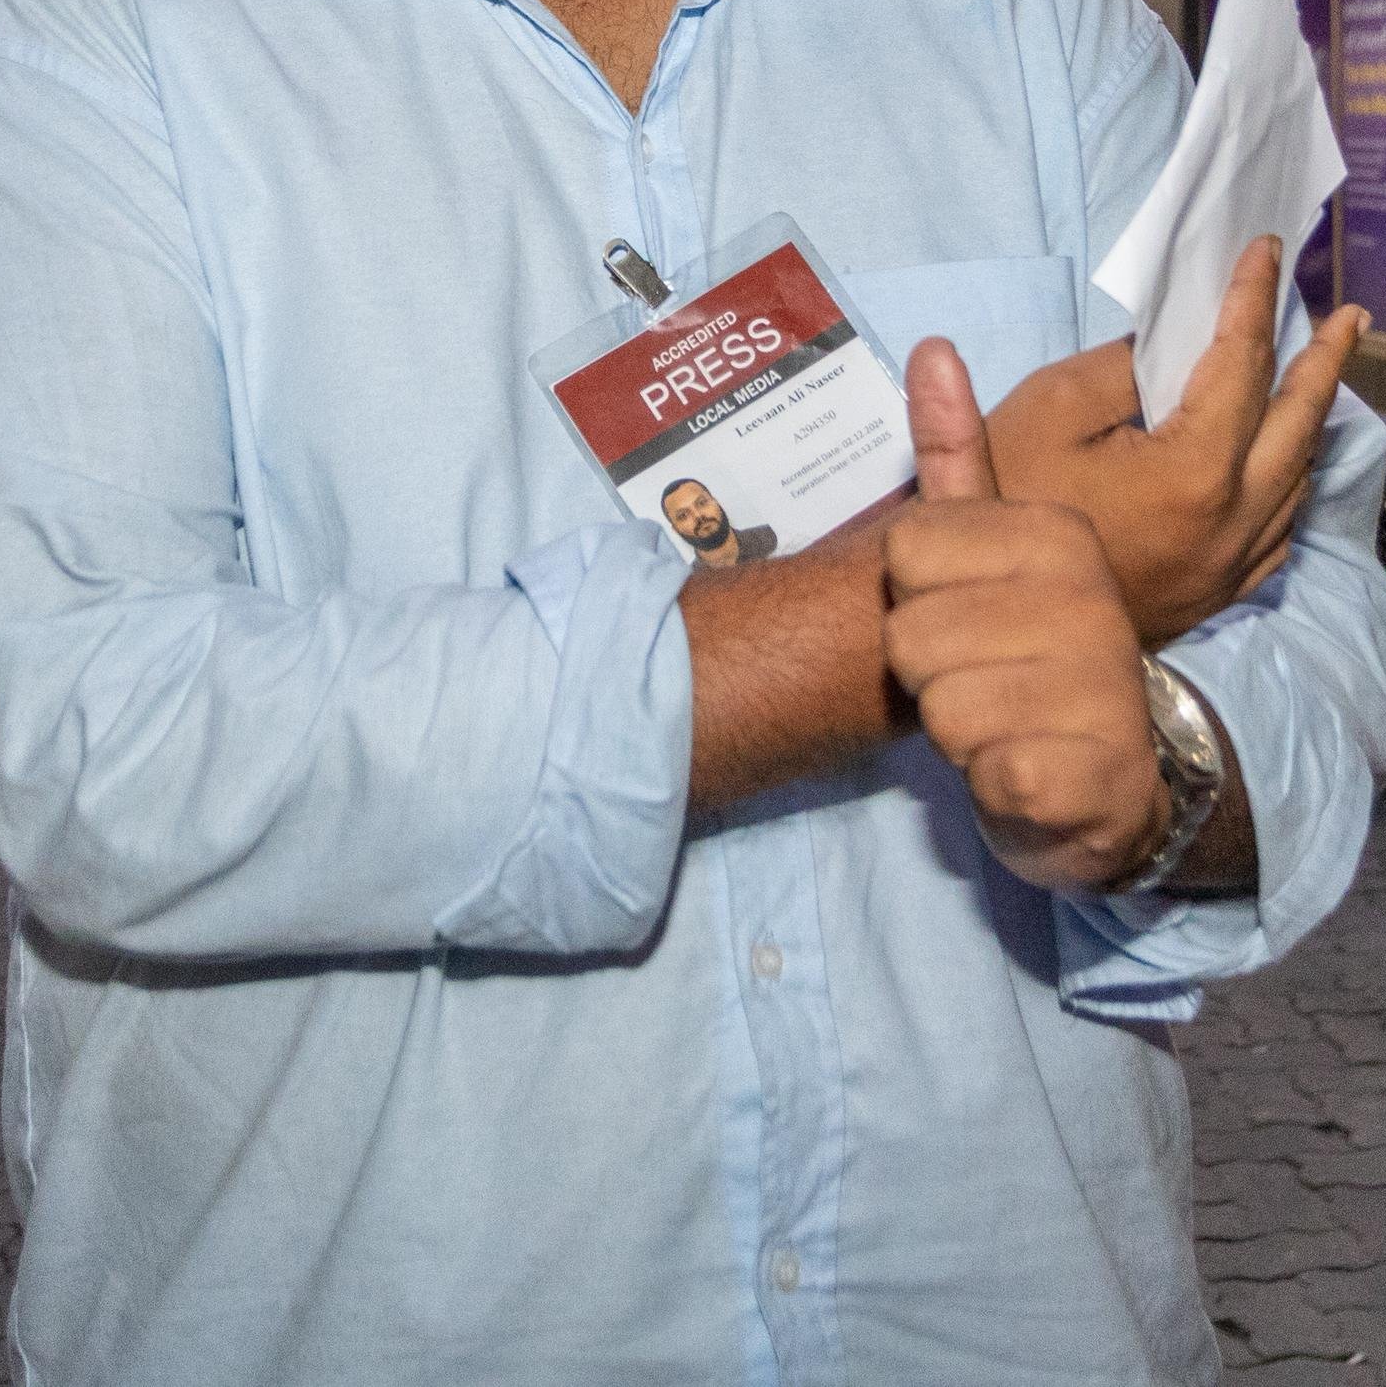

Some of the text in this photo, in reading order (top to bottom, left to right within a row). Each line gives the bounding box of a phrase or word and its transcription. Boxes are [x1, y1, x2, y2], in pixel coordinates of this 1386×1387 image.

[639, 317, 782, 422] PRESS
[651, 311, 738, 373] ACCREDITED
[686, 369, 783, 434] LOCAL MEDIA
[734, 364, 846, 438] Leevaan Ali Naseer
[780, 457, 822, 488] Accredited
[789, 469, 830, 499] Expiration
